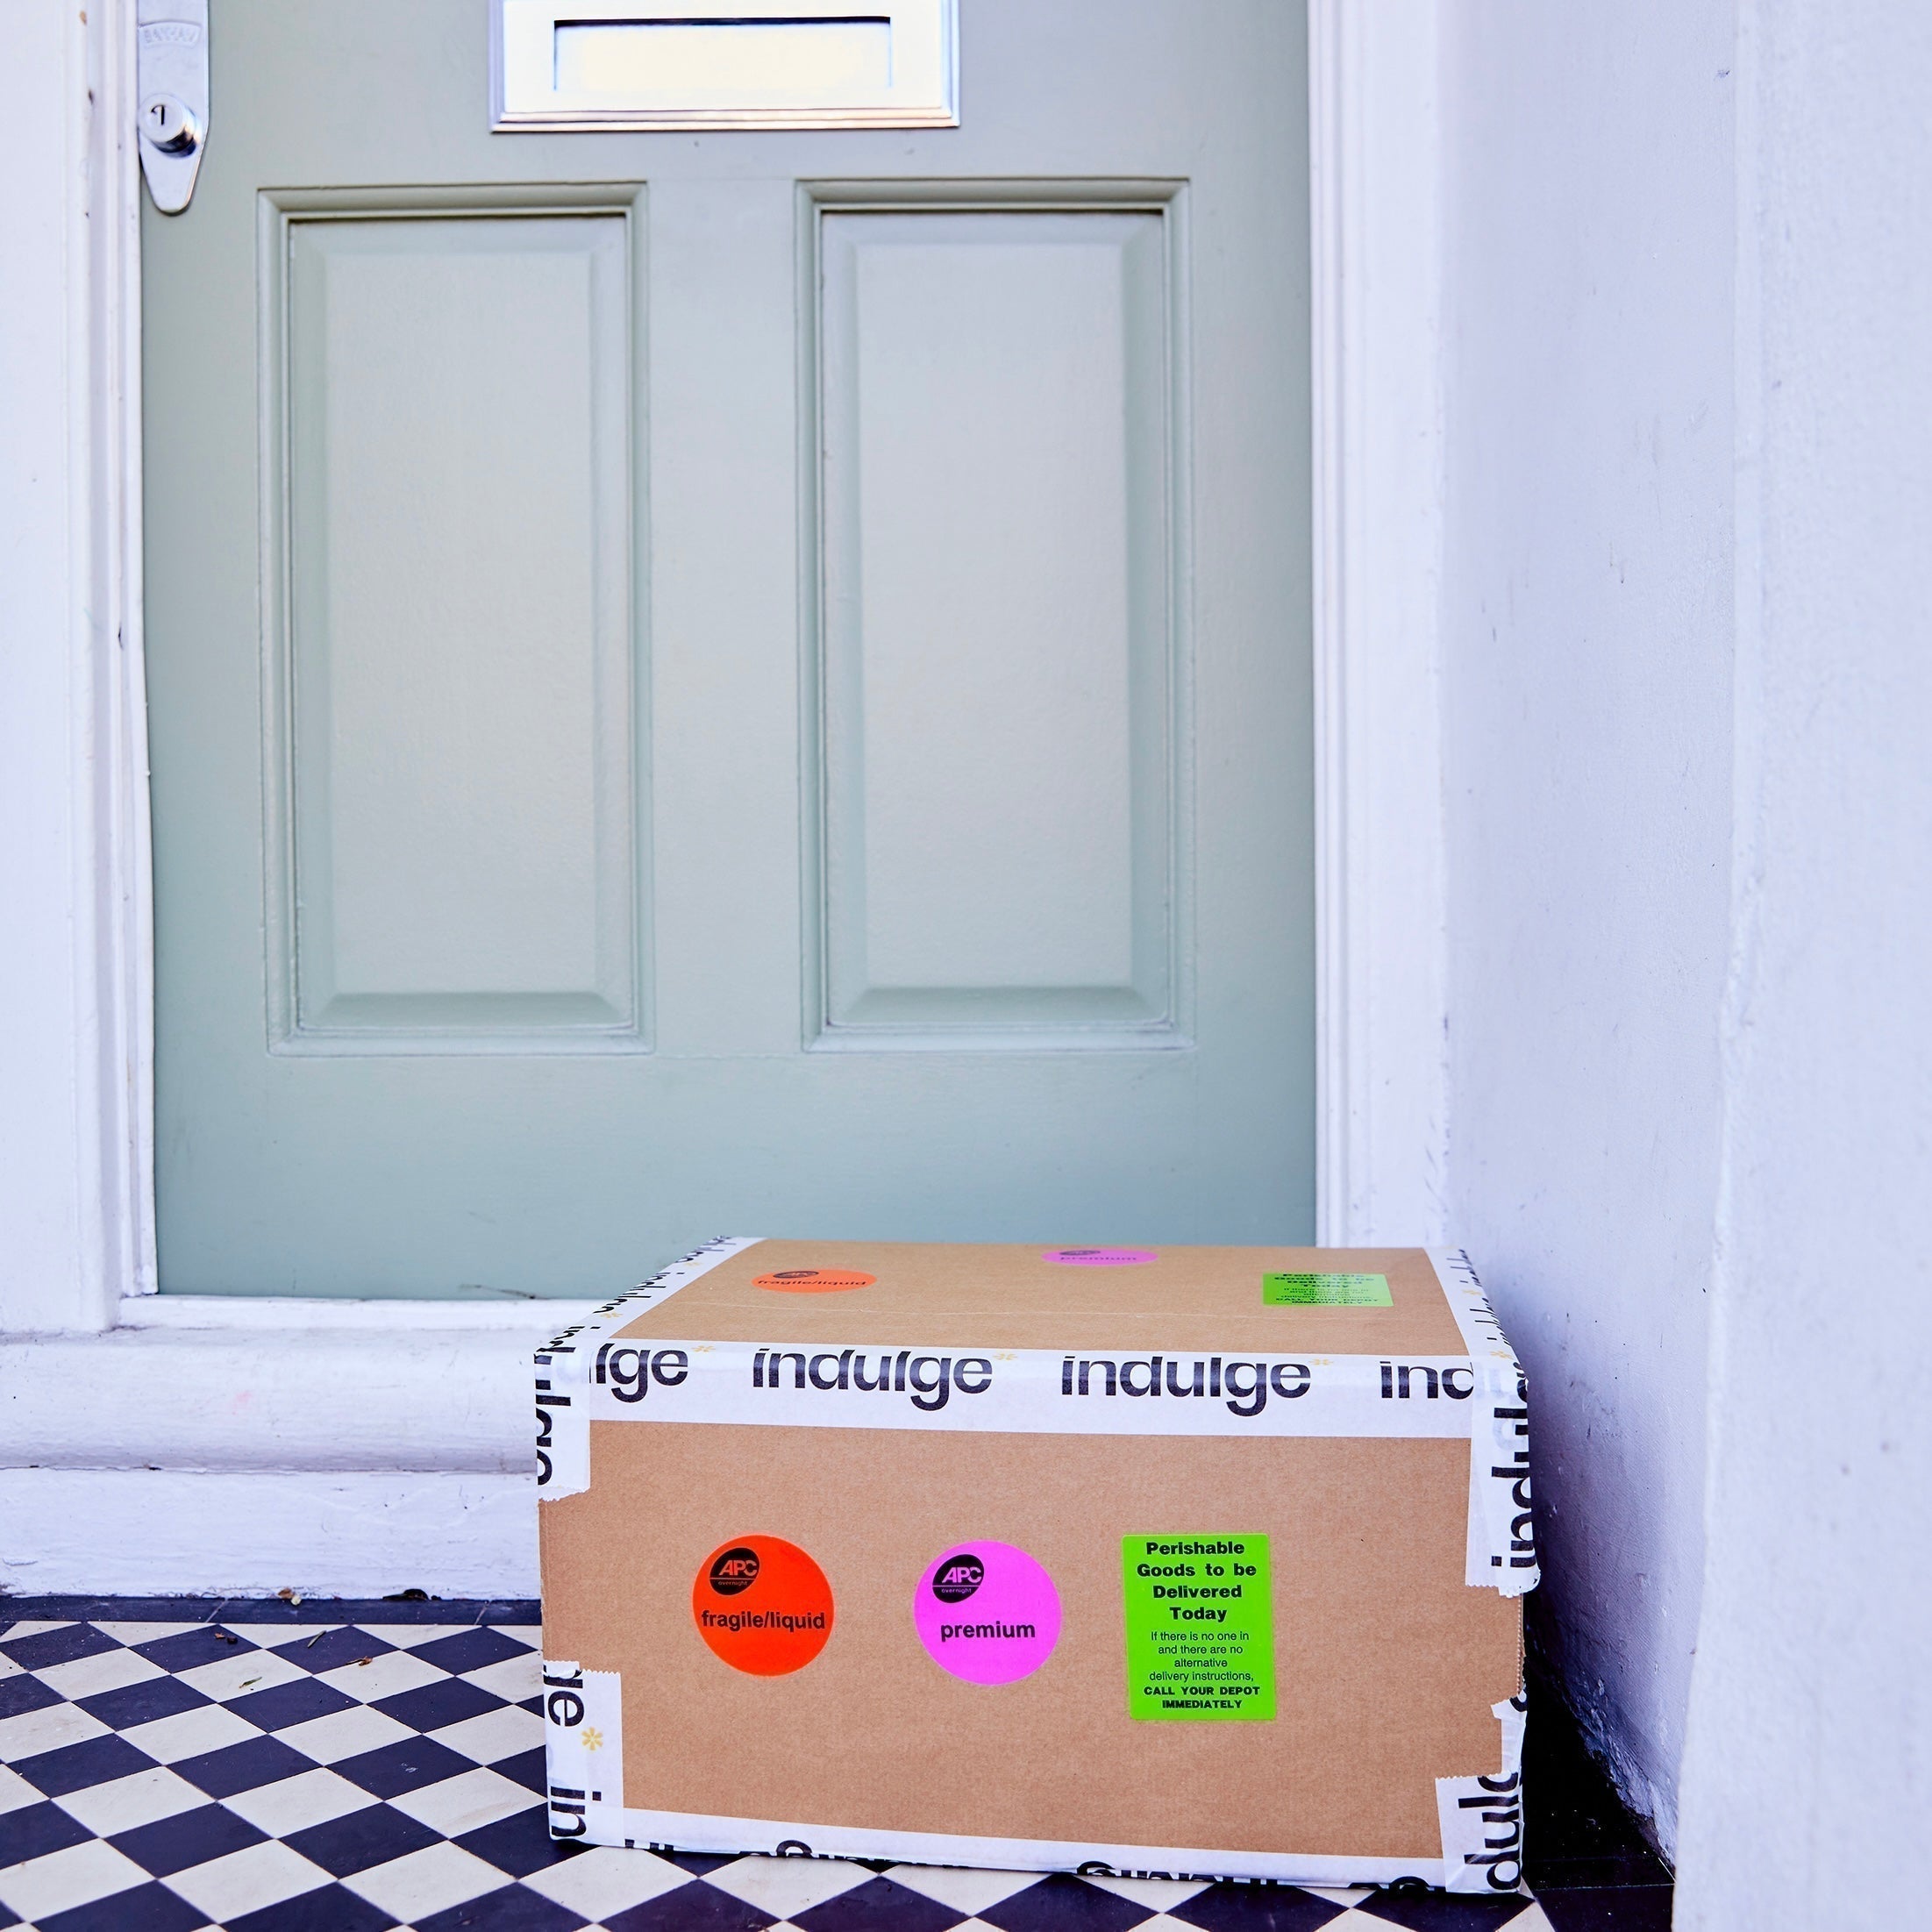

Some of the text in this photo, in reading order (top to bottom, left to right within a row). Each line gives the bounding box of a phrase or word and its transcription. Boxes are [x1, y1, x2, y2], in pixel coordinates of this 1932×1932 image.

[589, 1343, 688, 1403] lge
[752, 1347, 993, 1411] indulge
[1060, 1356, 1311, 1417] indulge
[1145, 1541, 1245, 1555] Perishable
[719, 1559, 758, 1577] APC
[941, 1566, 982, 1584] APC
[1137, 1563, 1257, 1577] Goods to be
[1152, 1585, 1243, 1599] Delivered
[702, 1609, 825, 1632] fragile/liquid
[1169, 1607, 1228, 1622] Today
[940, 1621, 1035, 1643] premium
[1151, 1631, 1158, 1641] If
[1159, 1631, 1187, 1641] there
[1189, 1631, 1199, 1641] is
[1239, 1631, 1250, 1641] in
[1158, 1645, 1177, 1654] and
[1180, 1645, 1208, 1654] there
[1173, 1658, 1228, 1668] alternative
[1149, 1672, 1254, 1683] delivery instructions,
[1144, 1686, 1260, 1695] CALL YOUR DEPOT
[1162, 1699, 1243, 1709] IMMEDIATELY
